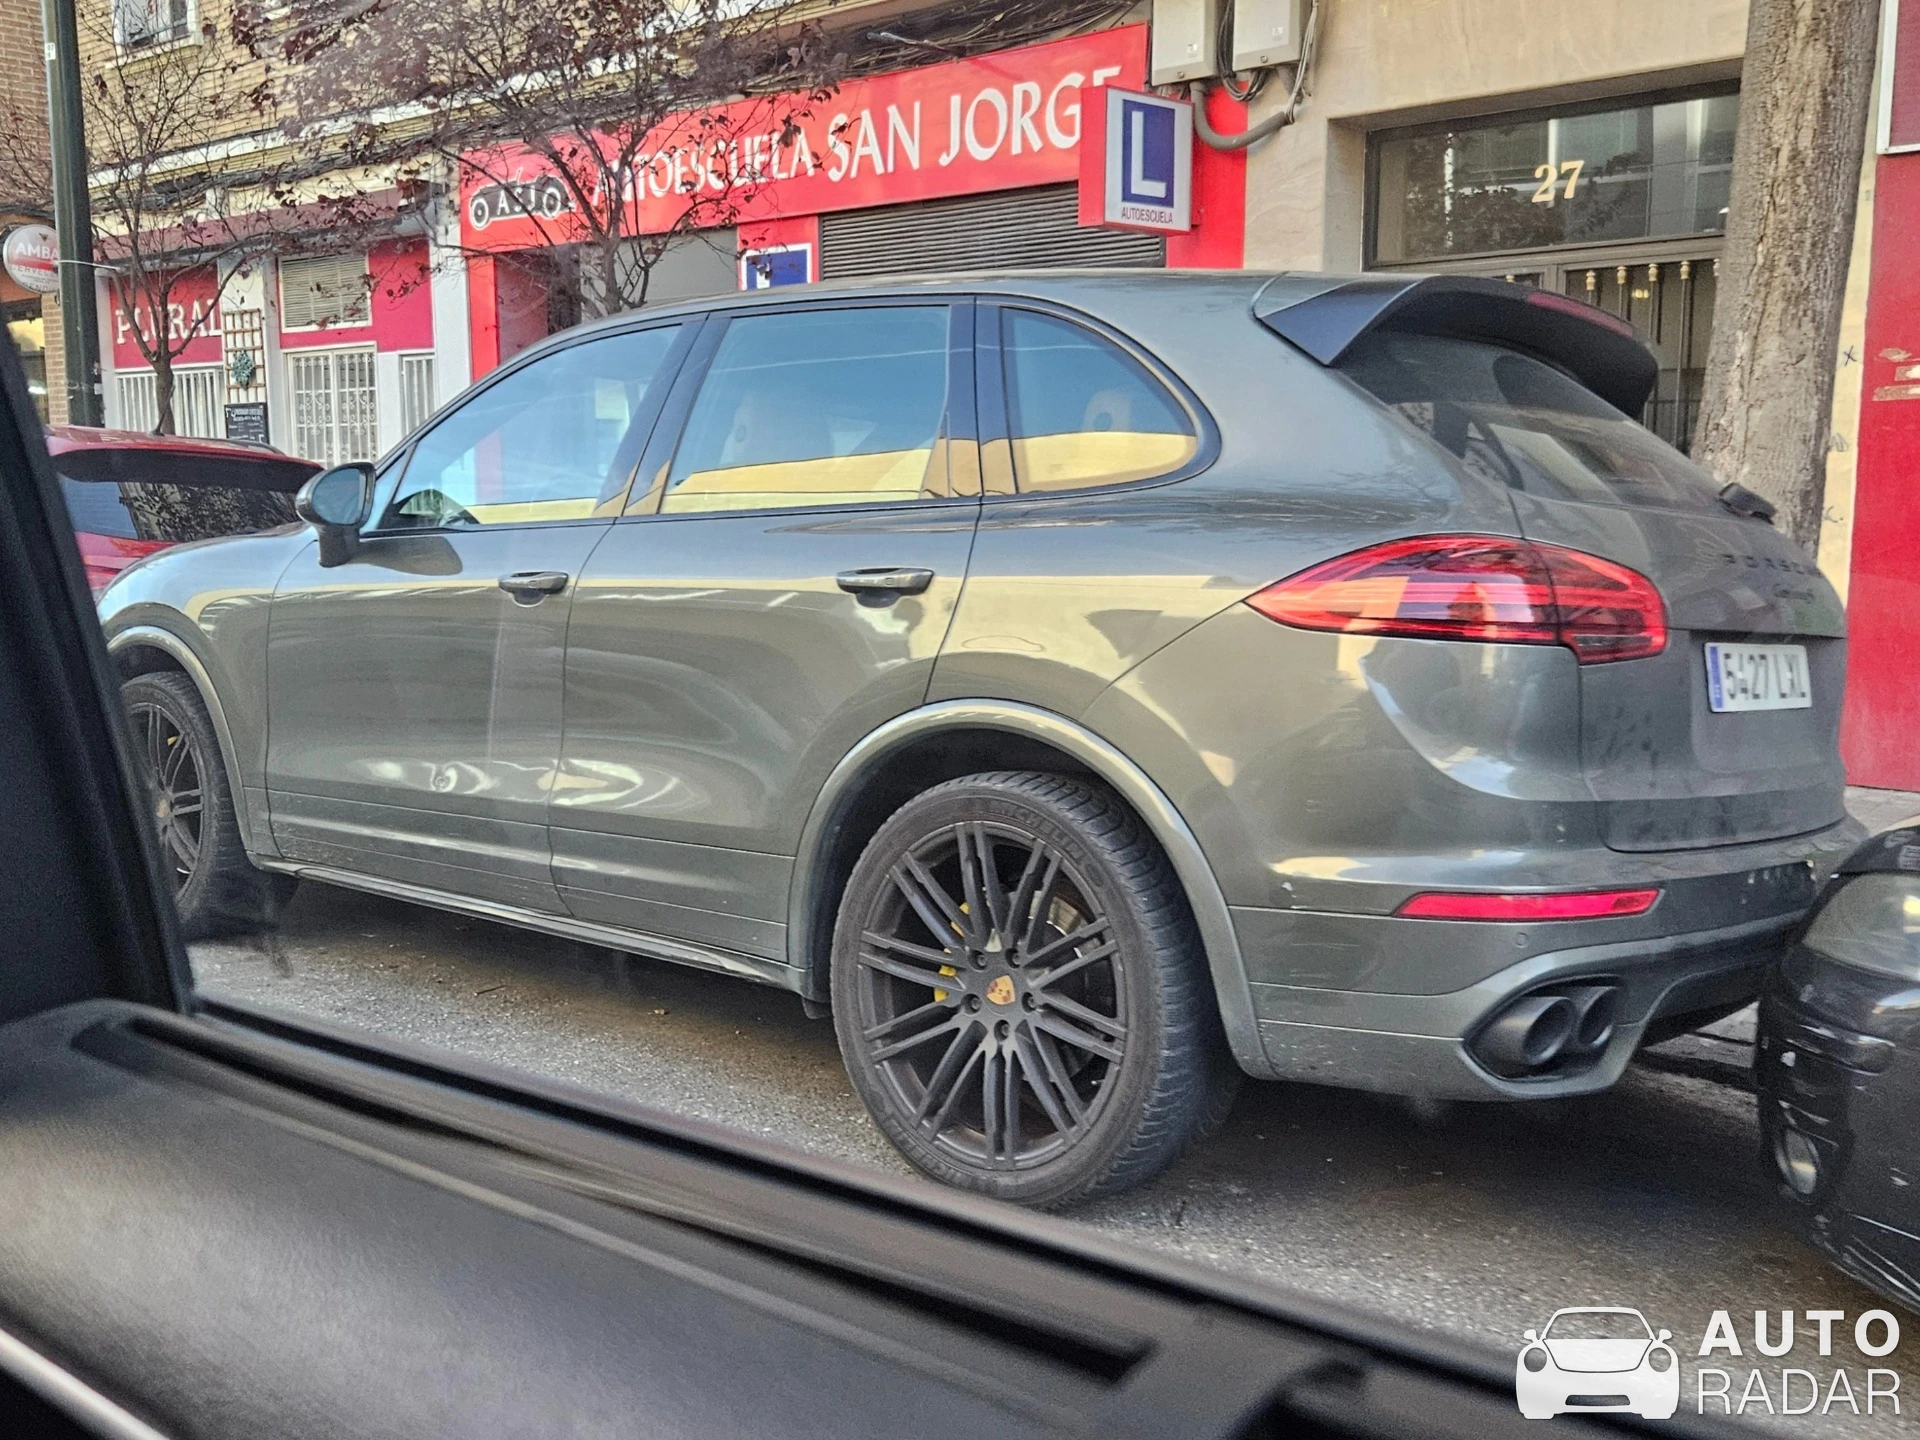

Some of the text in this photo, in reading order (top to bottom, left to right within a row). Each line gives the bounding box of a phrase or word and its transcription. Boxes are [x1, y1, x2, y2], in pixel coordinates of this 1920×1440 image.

[828, 100, 921, 182] SAN
[938, 65, 1122, 167] JORG
[1131, 110, 1167, 198] L
[1532, 160, 1585, 203] 27
[1121, 206, 1174, 224] AUTOESCUELA
[15, 242, 59, 261] AMBA
